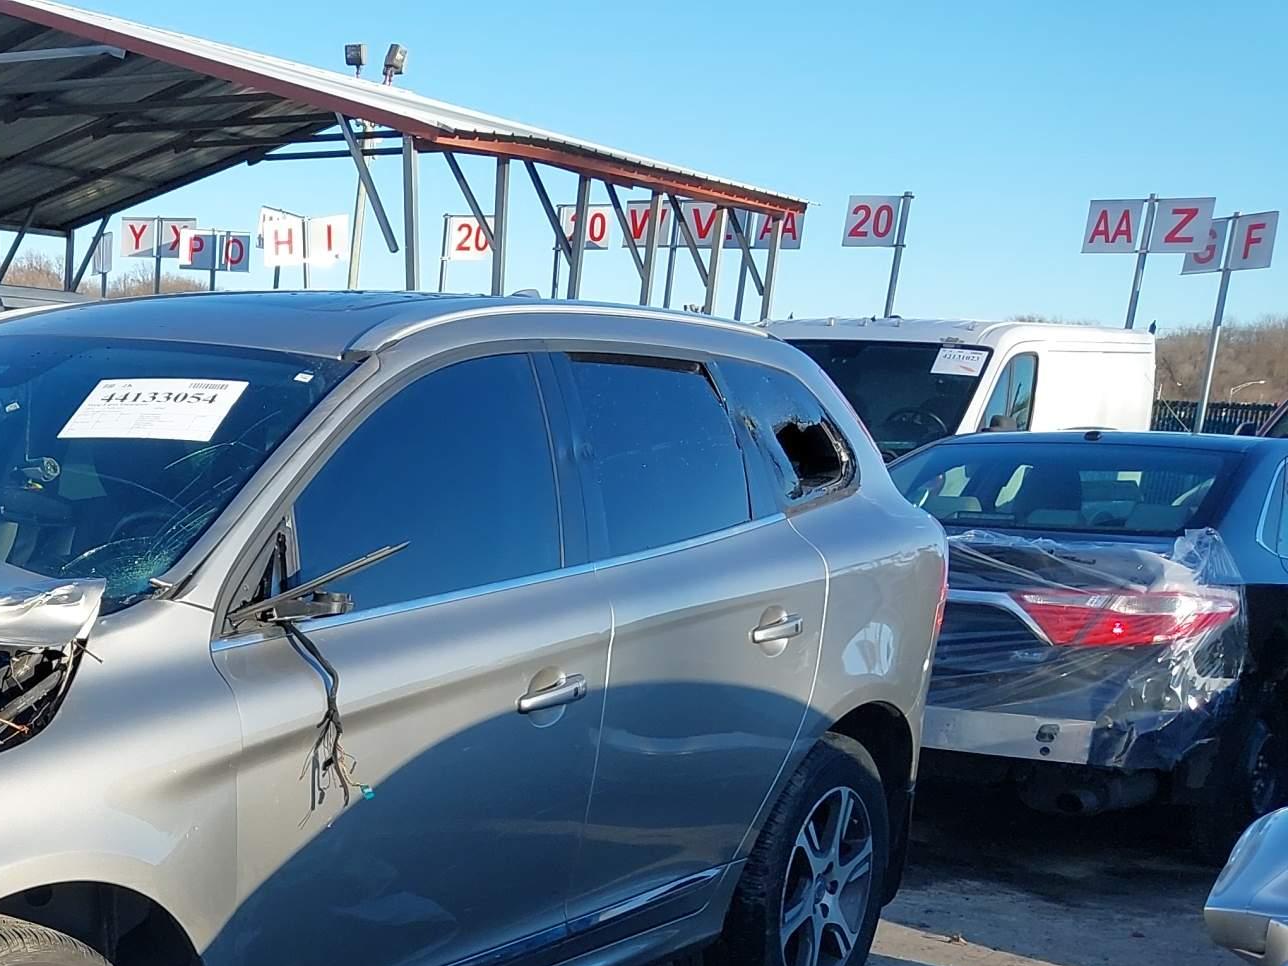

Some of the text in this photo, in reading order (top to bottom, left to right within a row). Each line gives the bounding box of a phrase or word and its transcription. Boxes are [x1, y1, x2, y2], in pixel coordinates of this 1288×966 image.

[128, 224, 147, 250] Y
[849, 204, 893, 239] 20
[1088, 209, 1132, 244] AA
[1164, 208, 1199, 243] Z
[189, 236, 204, 264] P
[274, 228, 293, 256] H
[1242, 223, 1266, 260] F
[100, 391, 219, 405] 44133054
